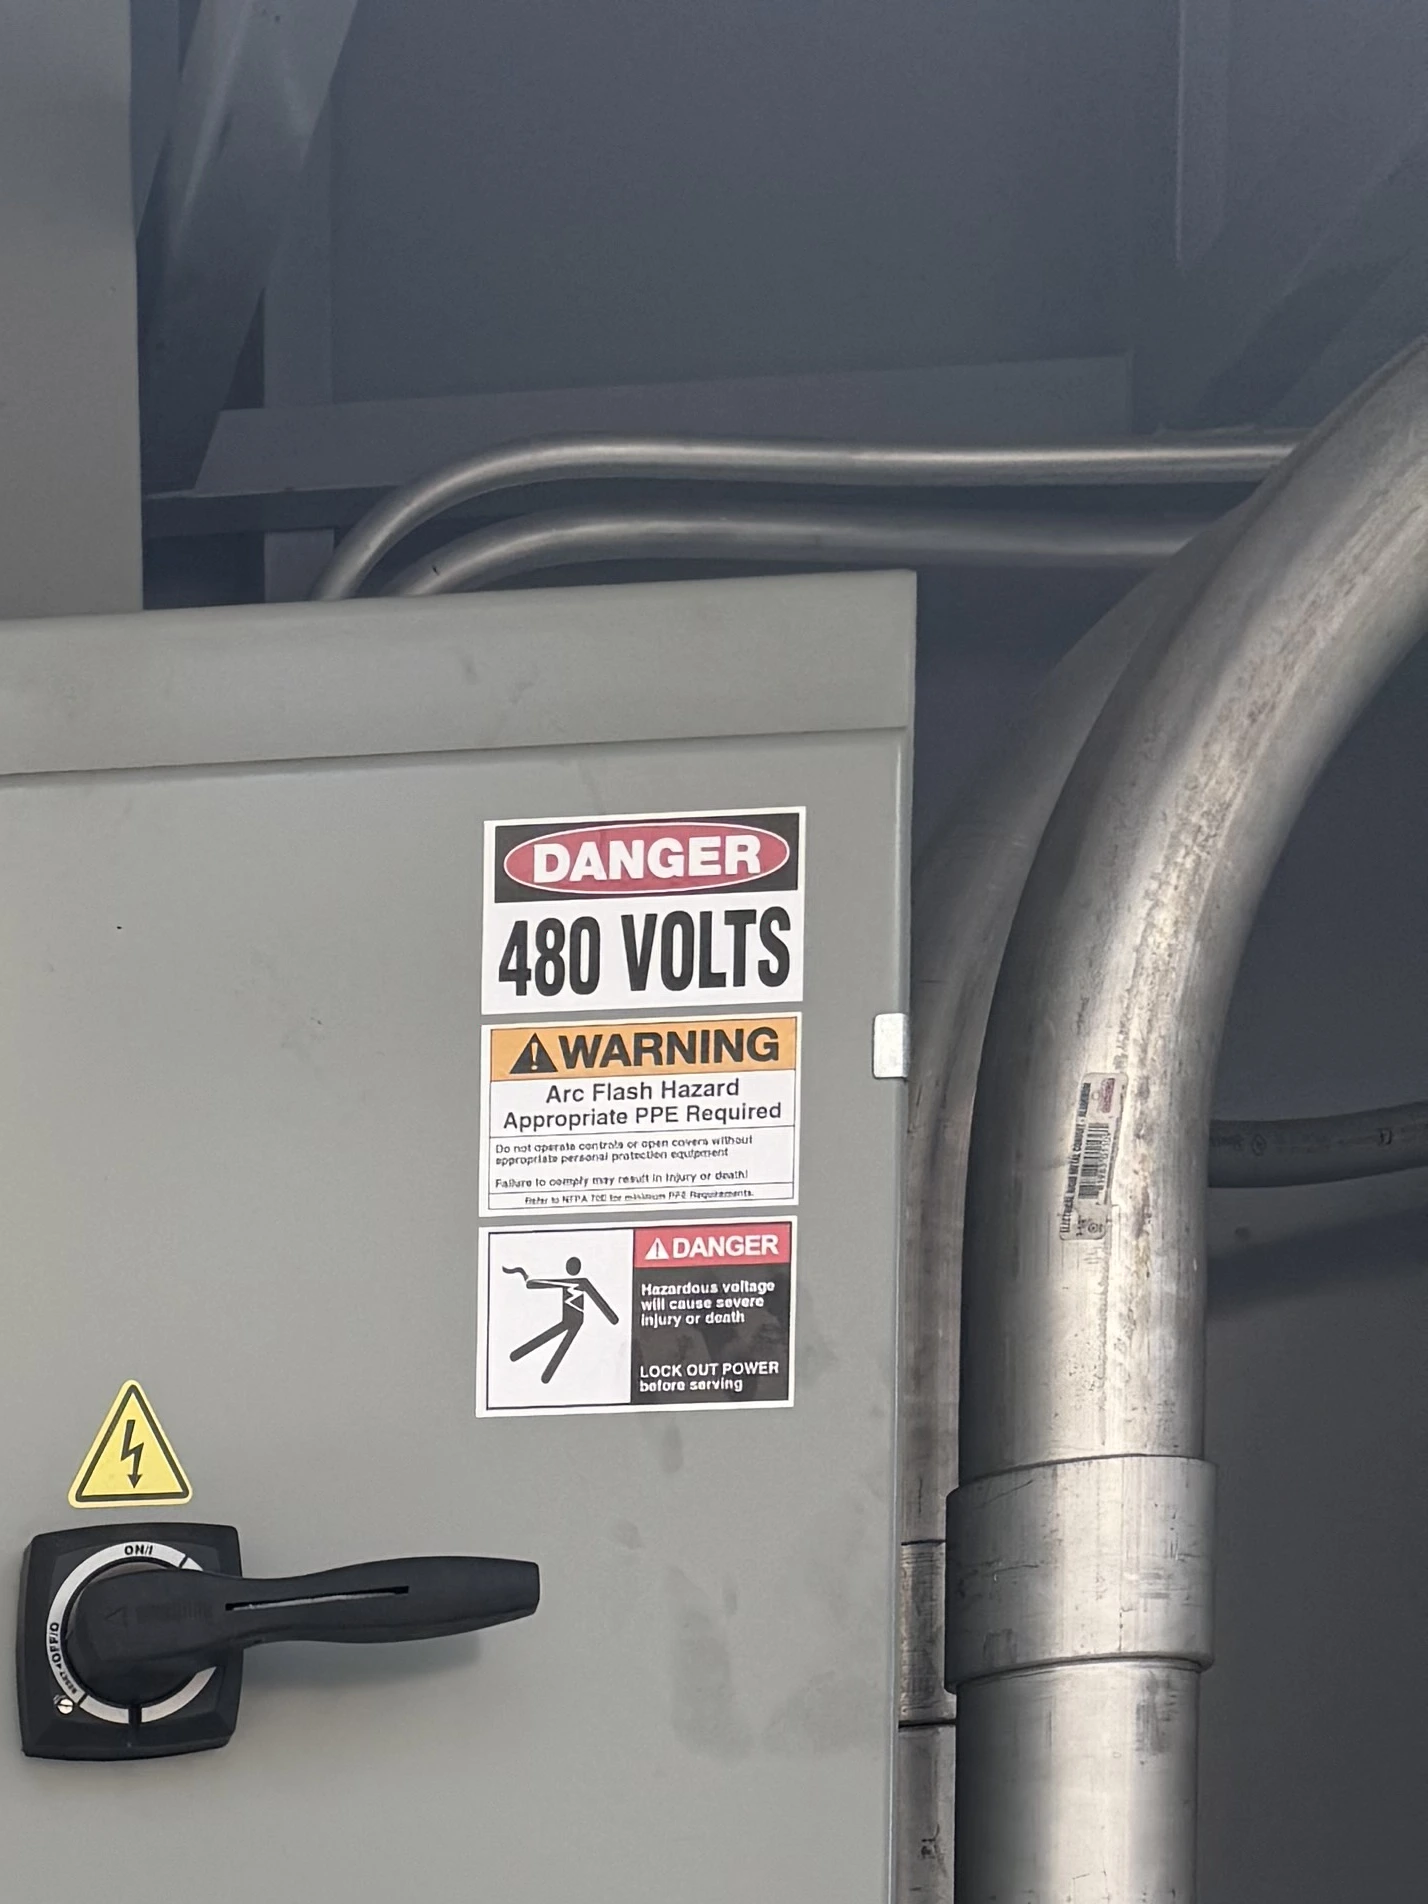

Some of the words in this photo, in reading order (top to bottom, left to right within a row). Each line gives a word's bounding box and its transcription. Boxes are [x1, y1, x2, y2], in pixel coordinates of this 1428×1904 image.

[533, 834, 762, 884] DANGER
[498, 916, 601, 997] 480
[620, 906, 791, 992] VOLTS
[558, 1026, 780, 1070] WARNING
[545, 1085, 584, 1104] Arc
[592, 1081, 652, 1102] Flash
[661, 1078, 739, 1099] Hazard
[503, 1109, 628, 1133] Appropriate
[635, 1106, 679, 1124] PPE
[686, 1102, 782, 1126] Required
[496, 1144, 511, 1154] Do
[514, 1143, 532, 1153] not
[534, 1142, 576, 1154] operate
[578, 1140, 624, 1151] controls
[627, 1141, 639, 1149] or
[641, 1140, 669, 1151] open
[672, 1137, 709, 1147] covers
[712, 1135, 753, 1146] without
[496, 1154, 558, 1166] appropriate
[561, 1152, 608, 1165] personal
[611, 1149, 668, 1163] protection
[670, 1148, 729, 1160] equipment
[496, 1178, 532, 1189] Failure
[535, 1178, 547, 1188] to
[549, 1175, 589, 1189] comply
[592, 1176, 615, 1187] may
[618, 1173, 649, 1184] result
[652, 1173, 663, 1182] in
[665, 1171, 697, 1183] injury
[699, 1172, 711, 1180] or
[551, 1196, 560, 1204] to
[672, 1234, 779, 1259] DANGER
[641, 1283, 718, 1296] Hazardous
[722, 1281, 776, 1295] voltage
[641, 1298, 666, 1311] will
[668, 1298, 712, 1310] cause
[716, 1297, 765, 1308] severe
[641, 1313, 682, 1327] injury
[685, 1314, 701, 1324] or
[705, 1312, 745, 1324] death
[640, 1365, 682, 1378] LOCK
[686, 1363, 719, 1377] OUT
[722, 1361, 779, 1376] POWER
[640, 1380, 686, 1393] before
[689, 1378, 743, 1392] serving
[124, 1544, 154, 1556] ON/I
